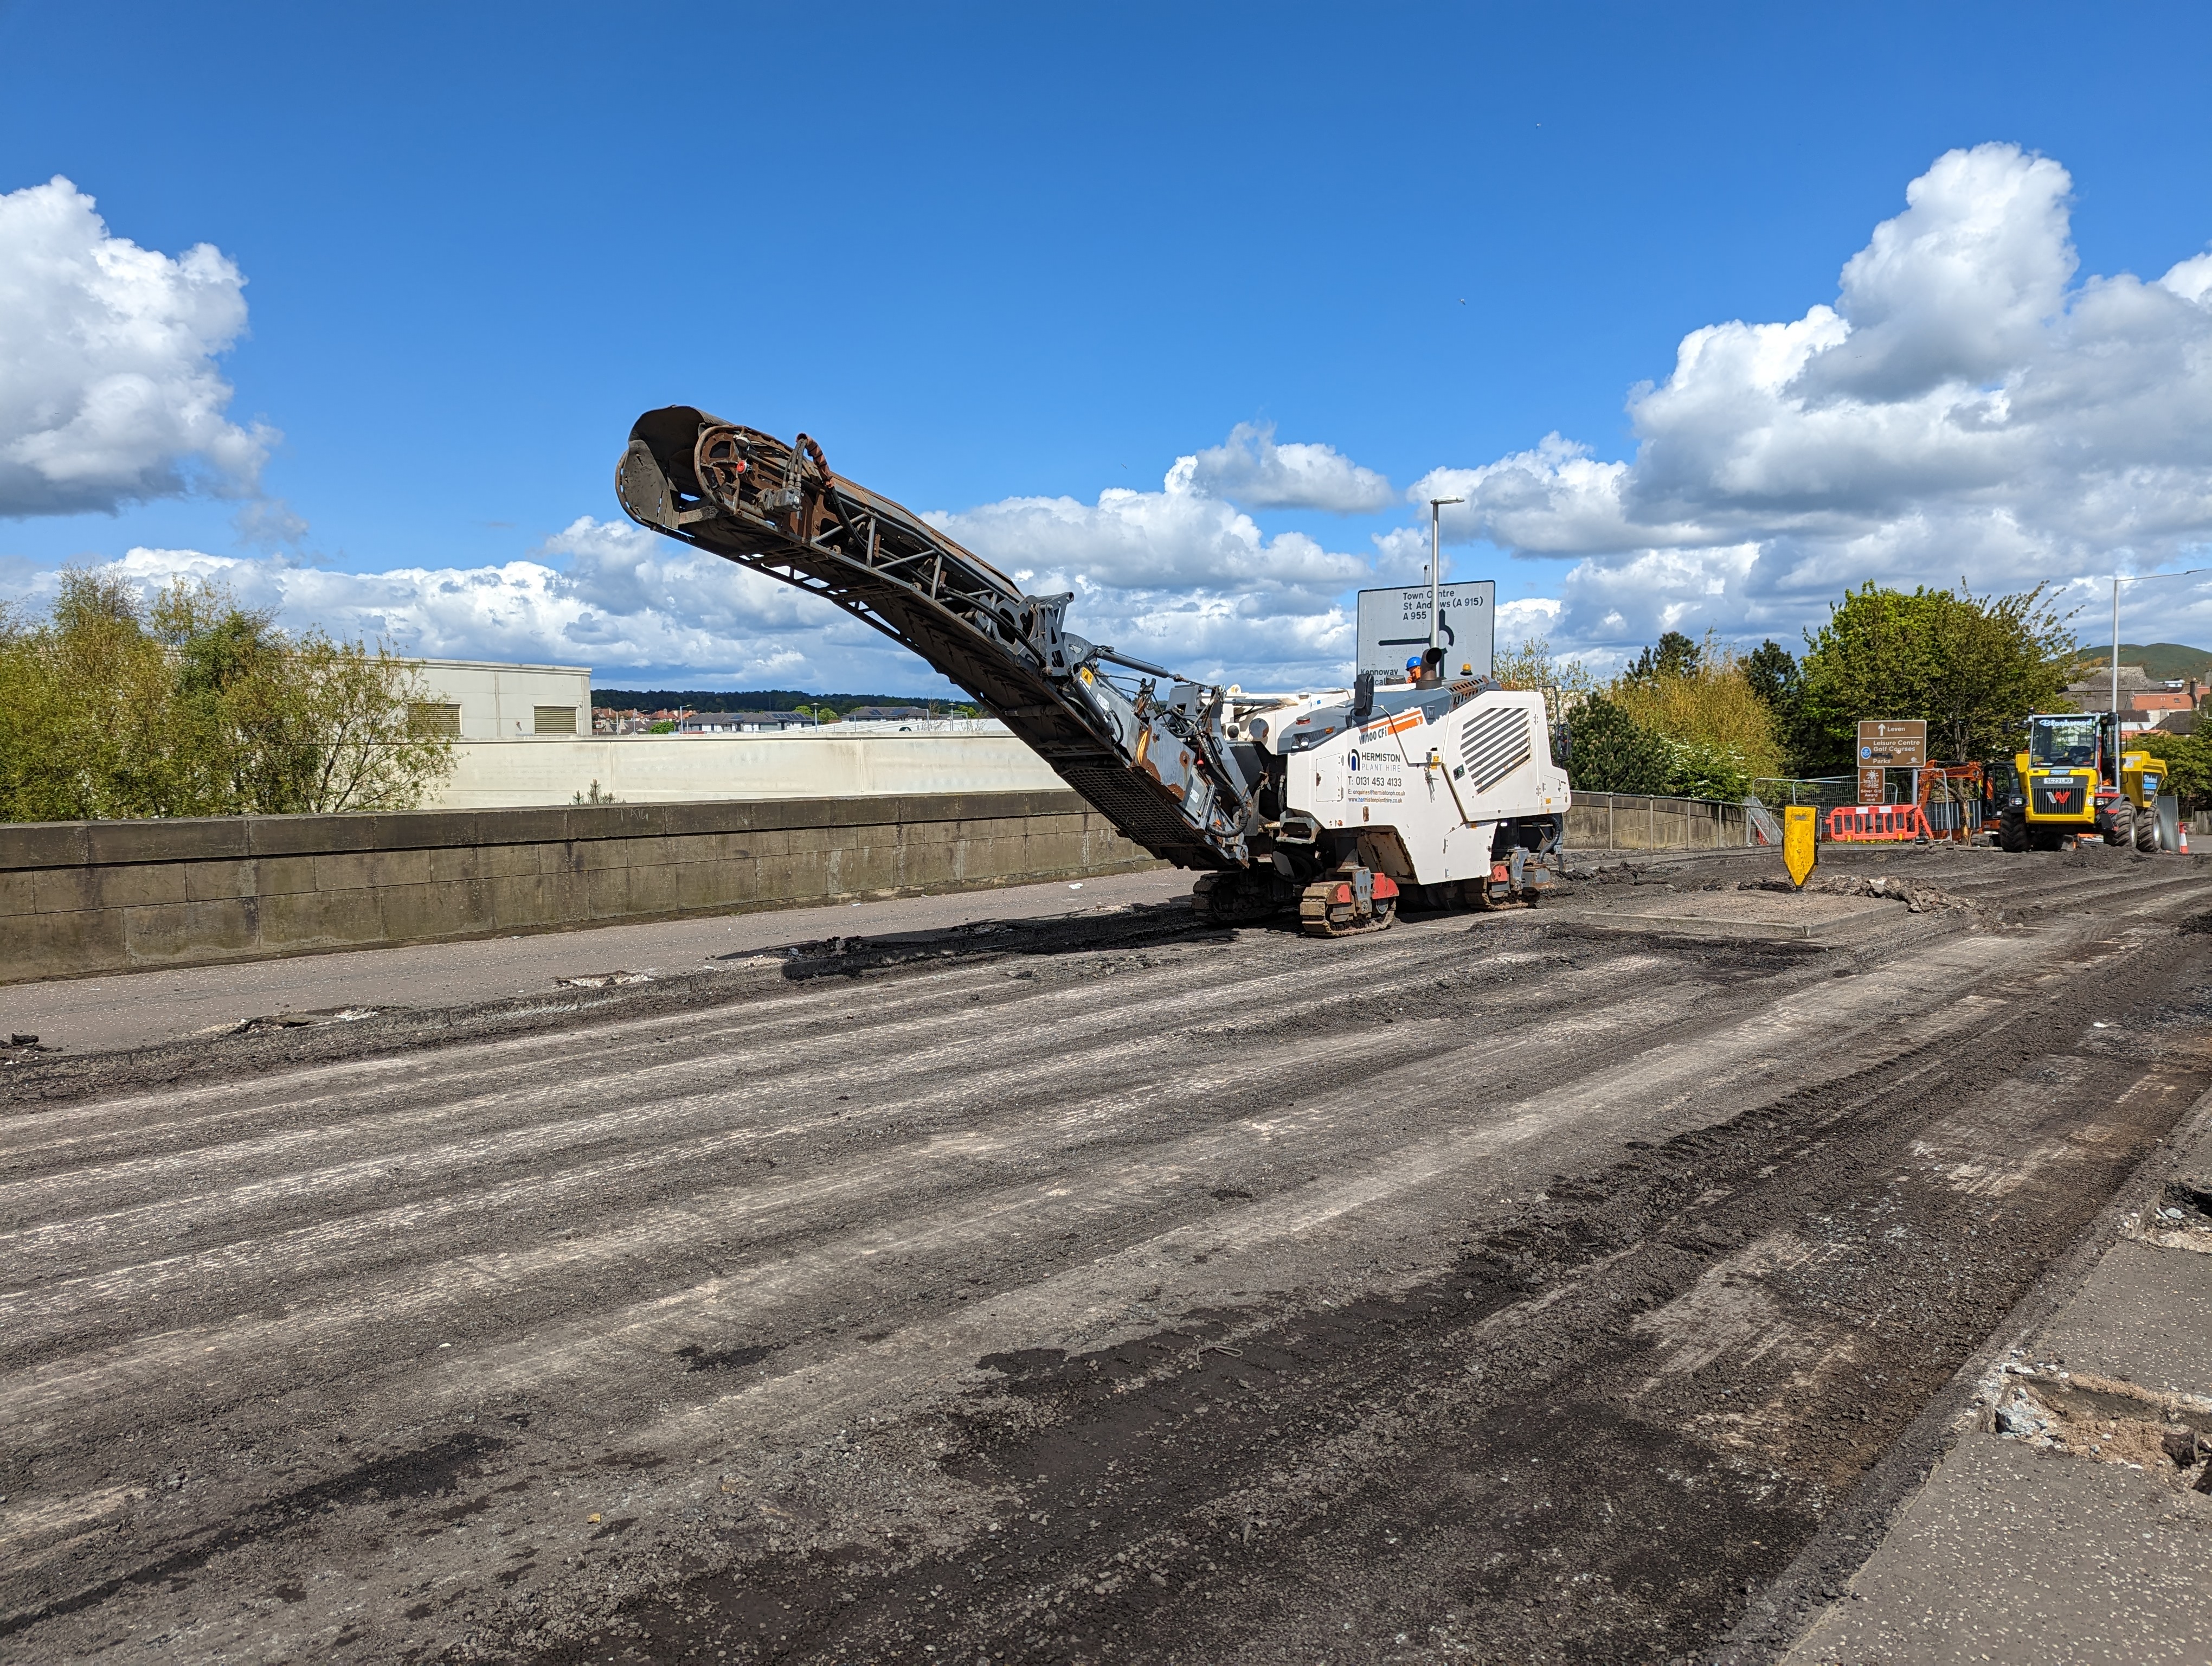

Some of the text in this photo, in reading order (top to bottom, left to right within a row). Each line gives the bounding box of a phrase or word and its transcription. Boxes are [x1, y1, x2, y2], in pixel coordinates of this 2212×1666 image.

[1403, 589, 1455, 600] Town Cntre
[1403, 596, 1483, 611] St Andws (A 915)
[1403, 611, 1427, 621] A 955
[1361, 752, 1401, 762] HERMISTON
[1361, 763, 1401, 772] PLANT HIRE
[1348, 776, 1402, 787] T: 0131 453 4133
